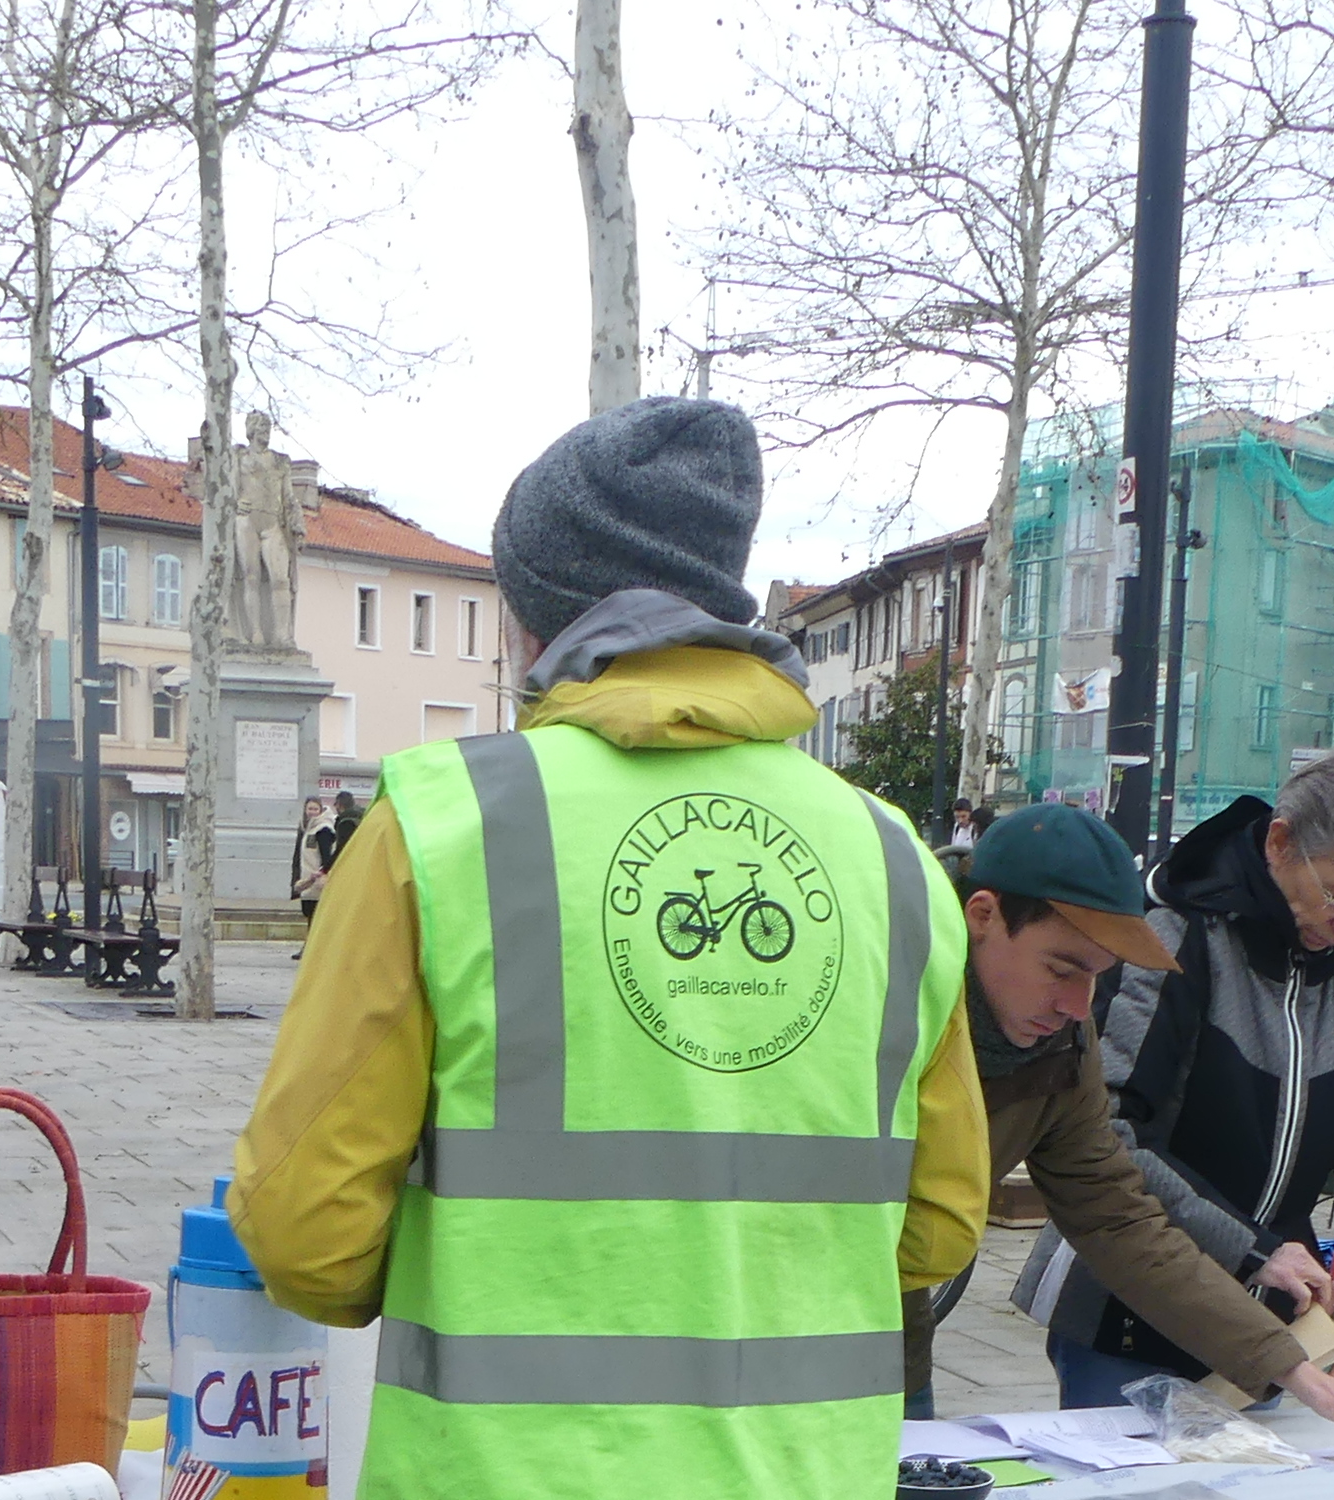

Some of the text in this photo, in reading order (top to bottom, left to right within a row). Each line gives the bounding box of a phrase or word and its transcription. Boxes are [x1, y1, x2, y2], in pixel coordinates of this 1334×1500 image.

[610, 798, 833, 923] GAILLACAVELO
[614, 937, 667, 1041] Ensemble,
[676, 1033, 709, 1062] vers
[713, 1049, 742, 1066] une
[748, 1013, 812, 1063] mobilité
[667, 975, 789, 998] gaillacavelo.fr
